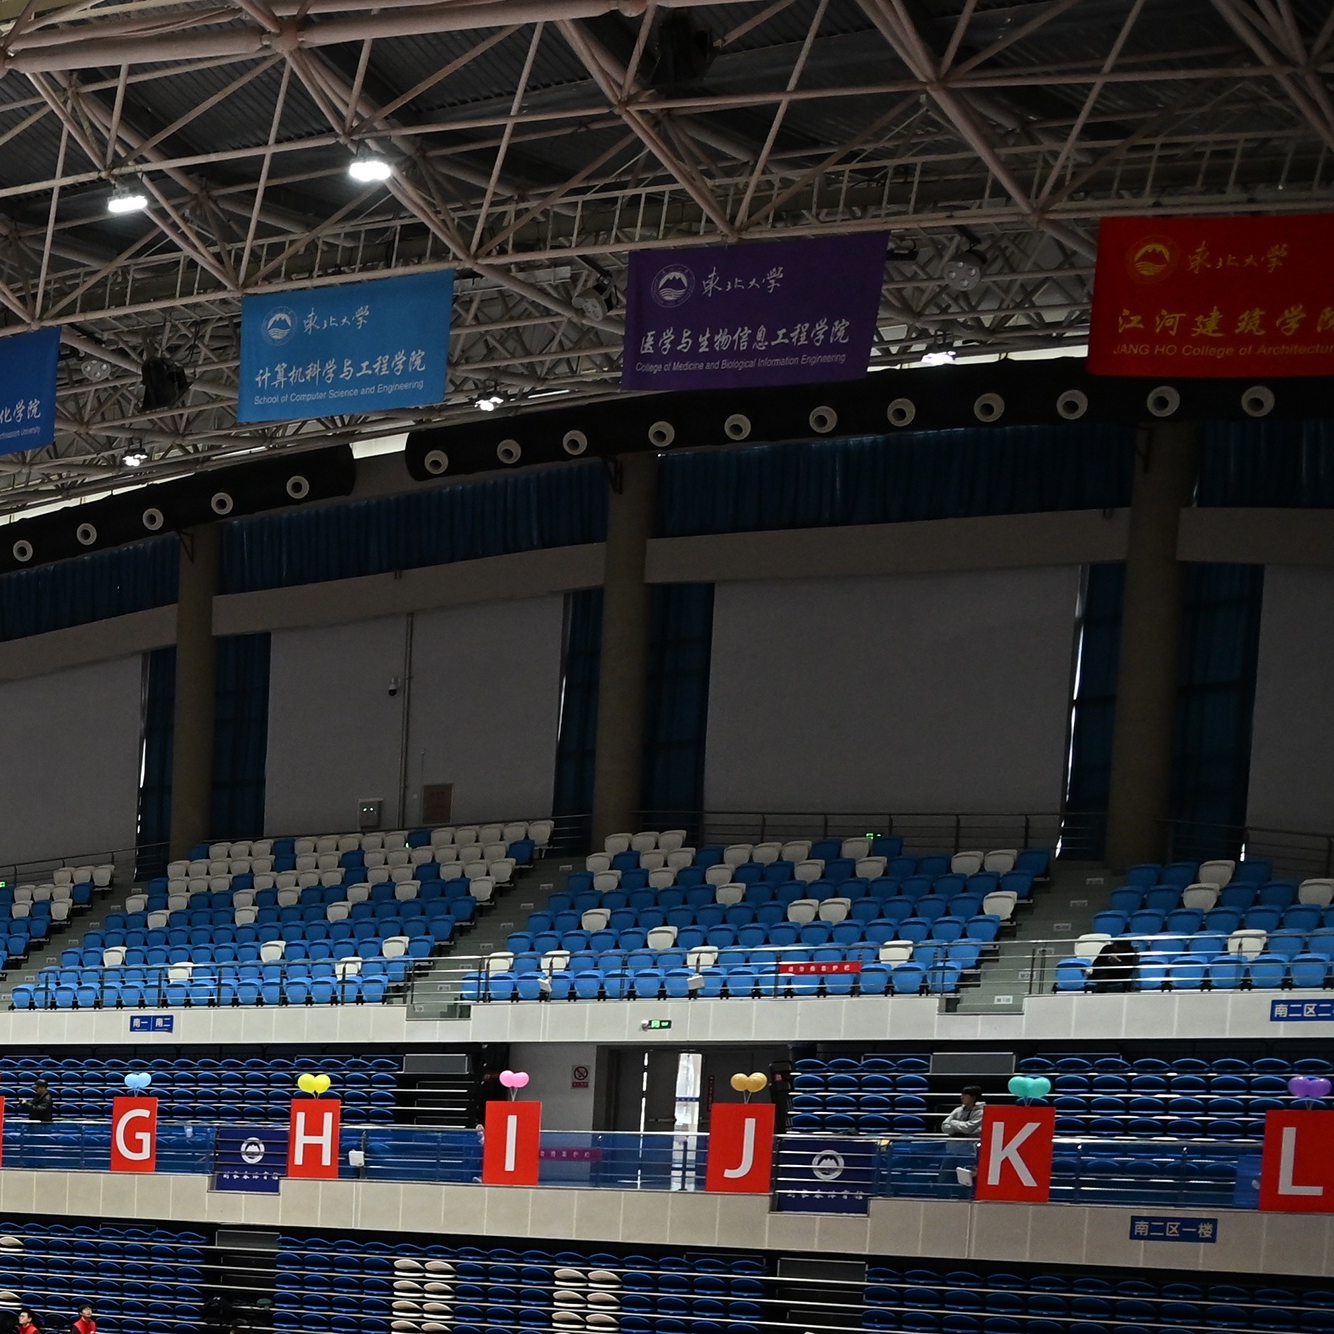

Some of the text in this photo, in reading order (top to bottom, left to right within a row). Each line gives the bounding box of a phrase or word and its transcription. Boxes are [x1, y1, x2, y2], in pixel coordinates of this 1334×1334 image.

[639, 317, 851, 355] 医学与生物信息工程学院
[1113, 343, 1150, 355] JANG
[1154, 343, 1178, 355] HO
[1182, 344, 1234, 358] College
[1238, 343, 1252, 355] of
[255, 349, 426, 389] 计算机科学与工程学院
[635, 353, 846, 373] College of Medicine and Biological Information Engineering
[254, 379, 424, 406] School of Computer Science and Engineering
[133, 1017, 171, 1028] 南一 南二
[1274, 1003, 1334, 1018] 南二区二
[115, 1109, 152, 1160] G
[294, 1111, 334, 1167] H
[504, 1114, 517, 1172] I
[724, 1118, 757, 1178] J
[986, 1120, 1042, 1188] K
[1282, 1127, 1324, 1196] L
[1134, 1221, 1213, 1239] 南二区一楼
